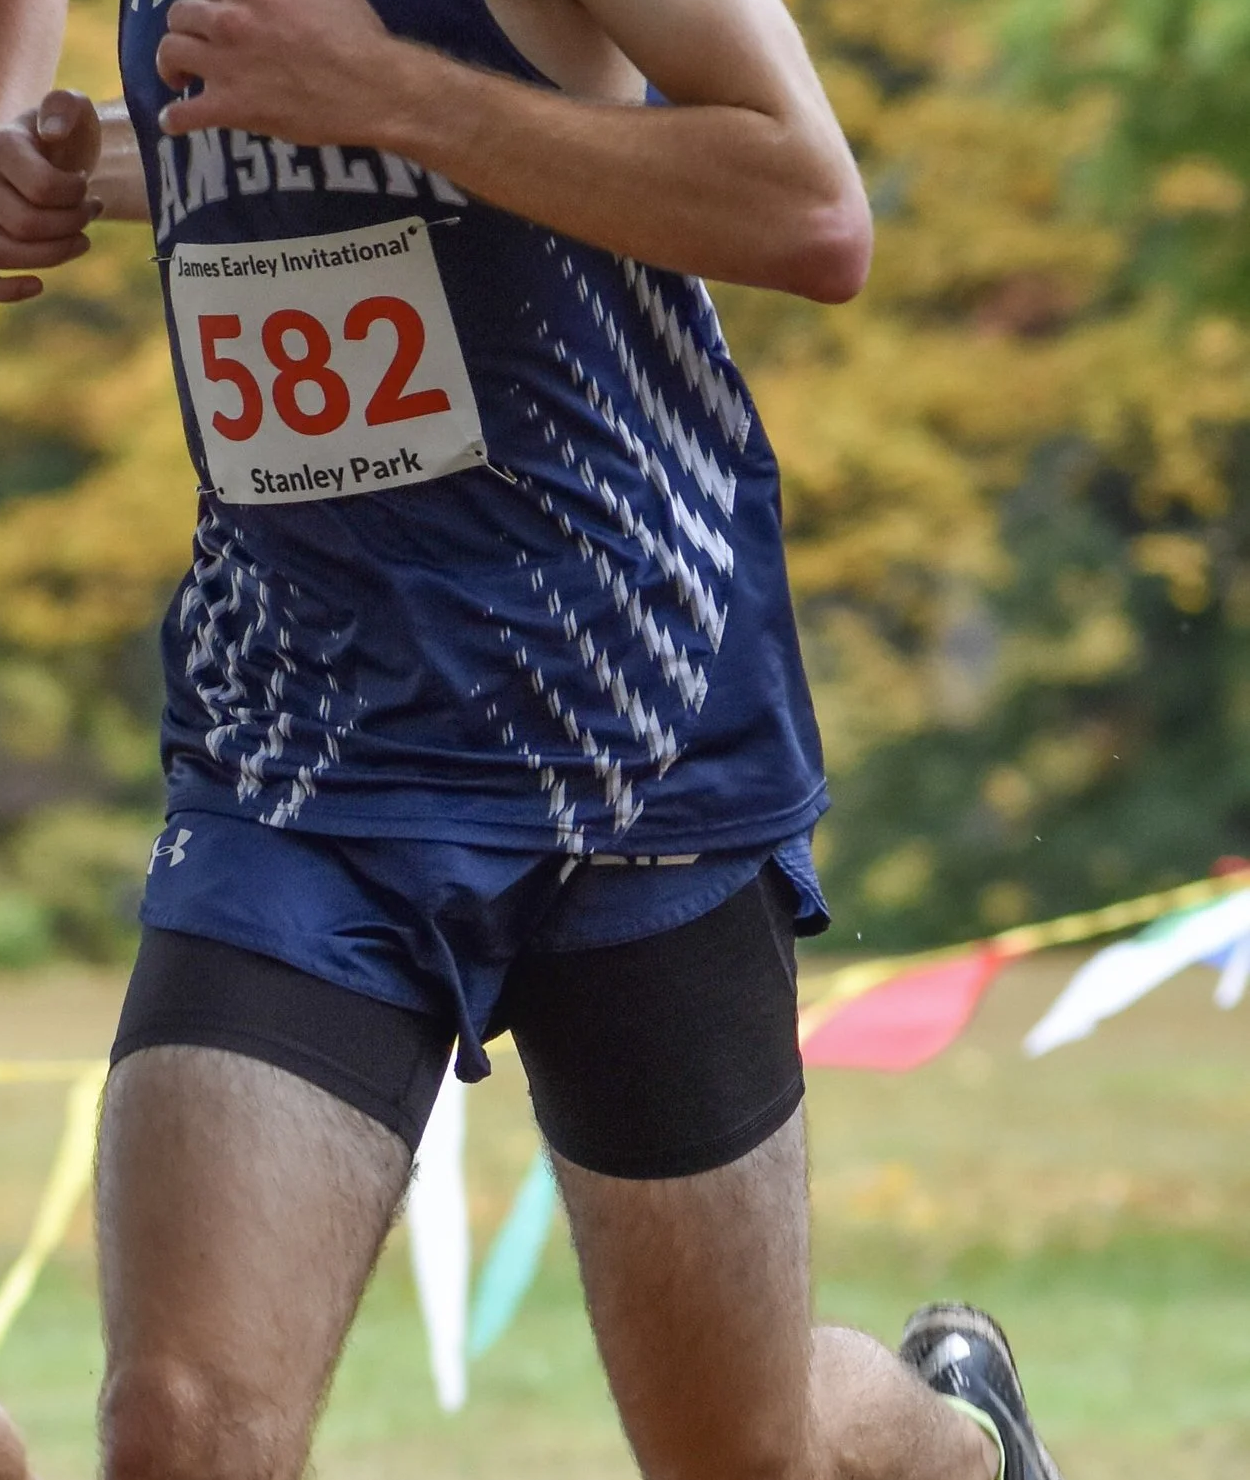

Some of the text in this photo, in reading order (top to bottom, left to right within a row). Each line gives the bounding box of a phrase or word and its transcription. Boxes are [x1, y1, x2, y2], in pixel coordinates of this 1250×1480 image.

[177, 231, 410, 279] James Earley Invitational
[197, 295, 452, 442] 582
[250, 447, 423, 496] Stanley Park
